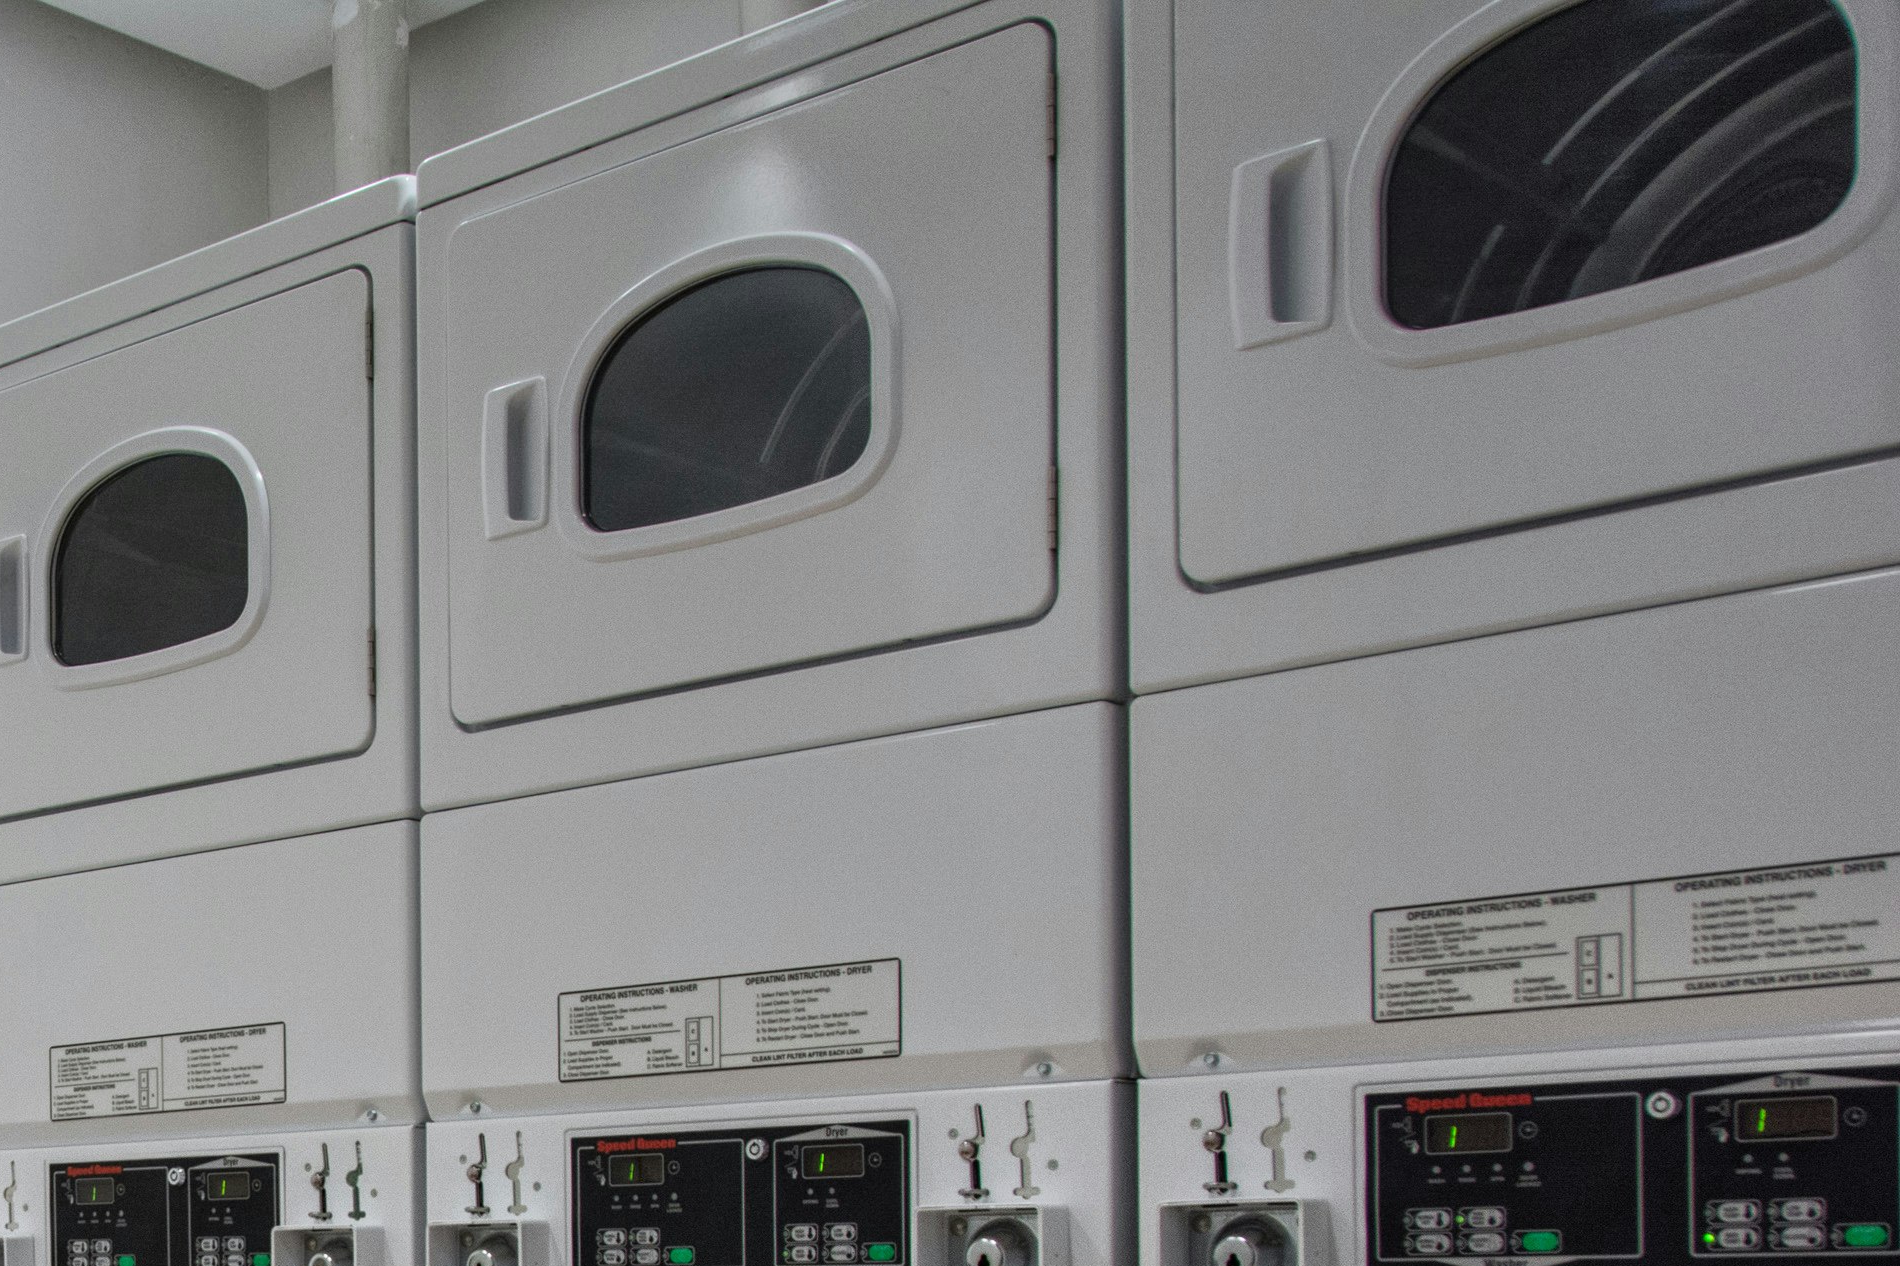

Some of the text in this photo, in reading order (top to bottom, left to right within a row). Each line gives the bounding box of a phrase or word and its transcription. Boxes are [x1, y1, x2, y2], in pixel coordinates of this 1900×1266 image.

[1675, 876, 1740, 892] OPERATING
[1745, 866, 1831, 884] INSTRUCTIONS
[1844, 861, 1885, 874] DRYER
[1408, 906, 1464, 920] OPERATING
[1467, 899, 1541, 915] INSTRUCTIONS
[1551, 893, 1596, 906] WASHER
[746, 973, 785, 986] OPERATING
[788, 967, 840, 981] INSTRUCTIONS
[847, 965, 872, 975] DRYER
[1685, 968, 1870, 991] CLEAN LINT FILTER AFTER EACH LOAD
[581, 991, 616, 1002] OPERATING
[618, 987, 664, 999] INSTRUCTIONS
[669, 984, 697, 993] WASHER
[180, 1034, 207, 1042] OPERATING
[209, 1030, 244, 1039] INSTRUCTIONS
[618, 1036, 651, 1044] INSTRUCTIONS
[92, 1043, 123, 1052] INSTRUCTIONS
[830, 1049, 845, 1057] EACH
[1773, 1075, 1809, 1088] Dryer
[1406, 1093, 1532, 1114] Speed Queen
[1758, 1108, 1766, 1132] 1
[826, 1128, 848, 1137] Dryer
[1449, 1126, 1457, 1148] 1
[597, 1138, 676, 1152] Speed Queen
[629, 1162, 634, 1181] 1
[820, 1153, 824, 1172] 1
